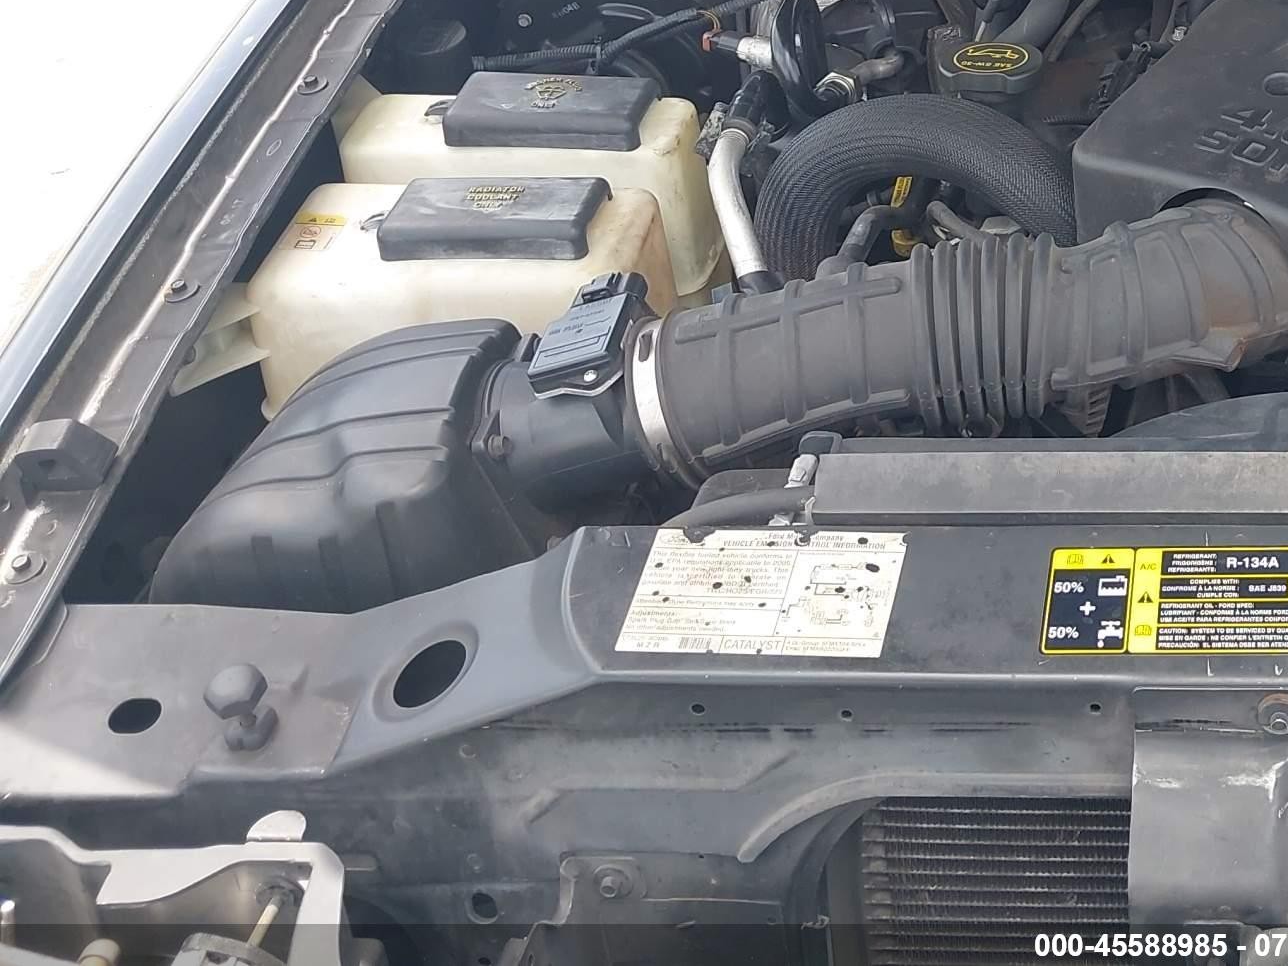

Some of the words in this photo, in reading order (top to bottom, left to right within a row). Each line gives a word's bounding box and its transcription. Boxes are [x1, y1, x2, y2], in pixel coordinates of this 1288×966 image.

[468, 186, 526, 194] RADIATOR
[755, 540, 793, 548] EMSION
[833, 542, 886, 550] INFORMATION
[1226, 556, 1279, 568] R-134A
[1054, 582, 1084, 594] 50%
[1048, 626, 1080, 638] 50%
[724, 639, 780, 650] CATALYST
